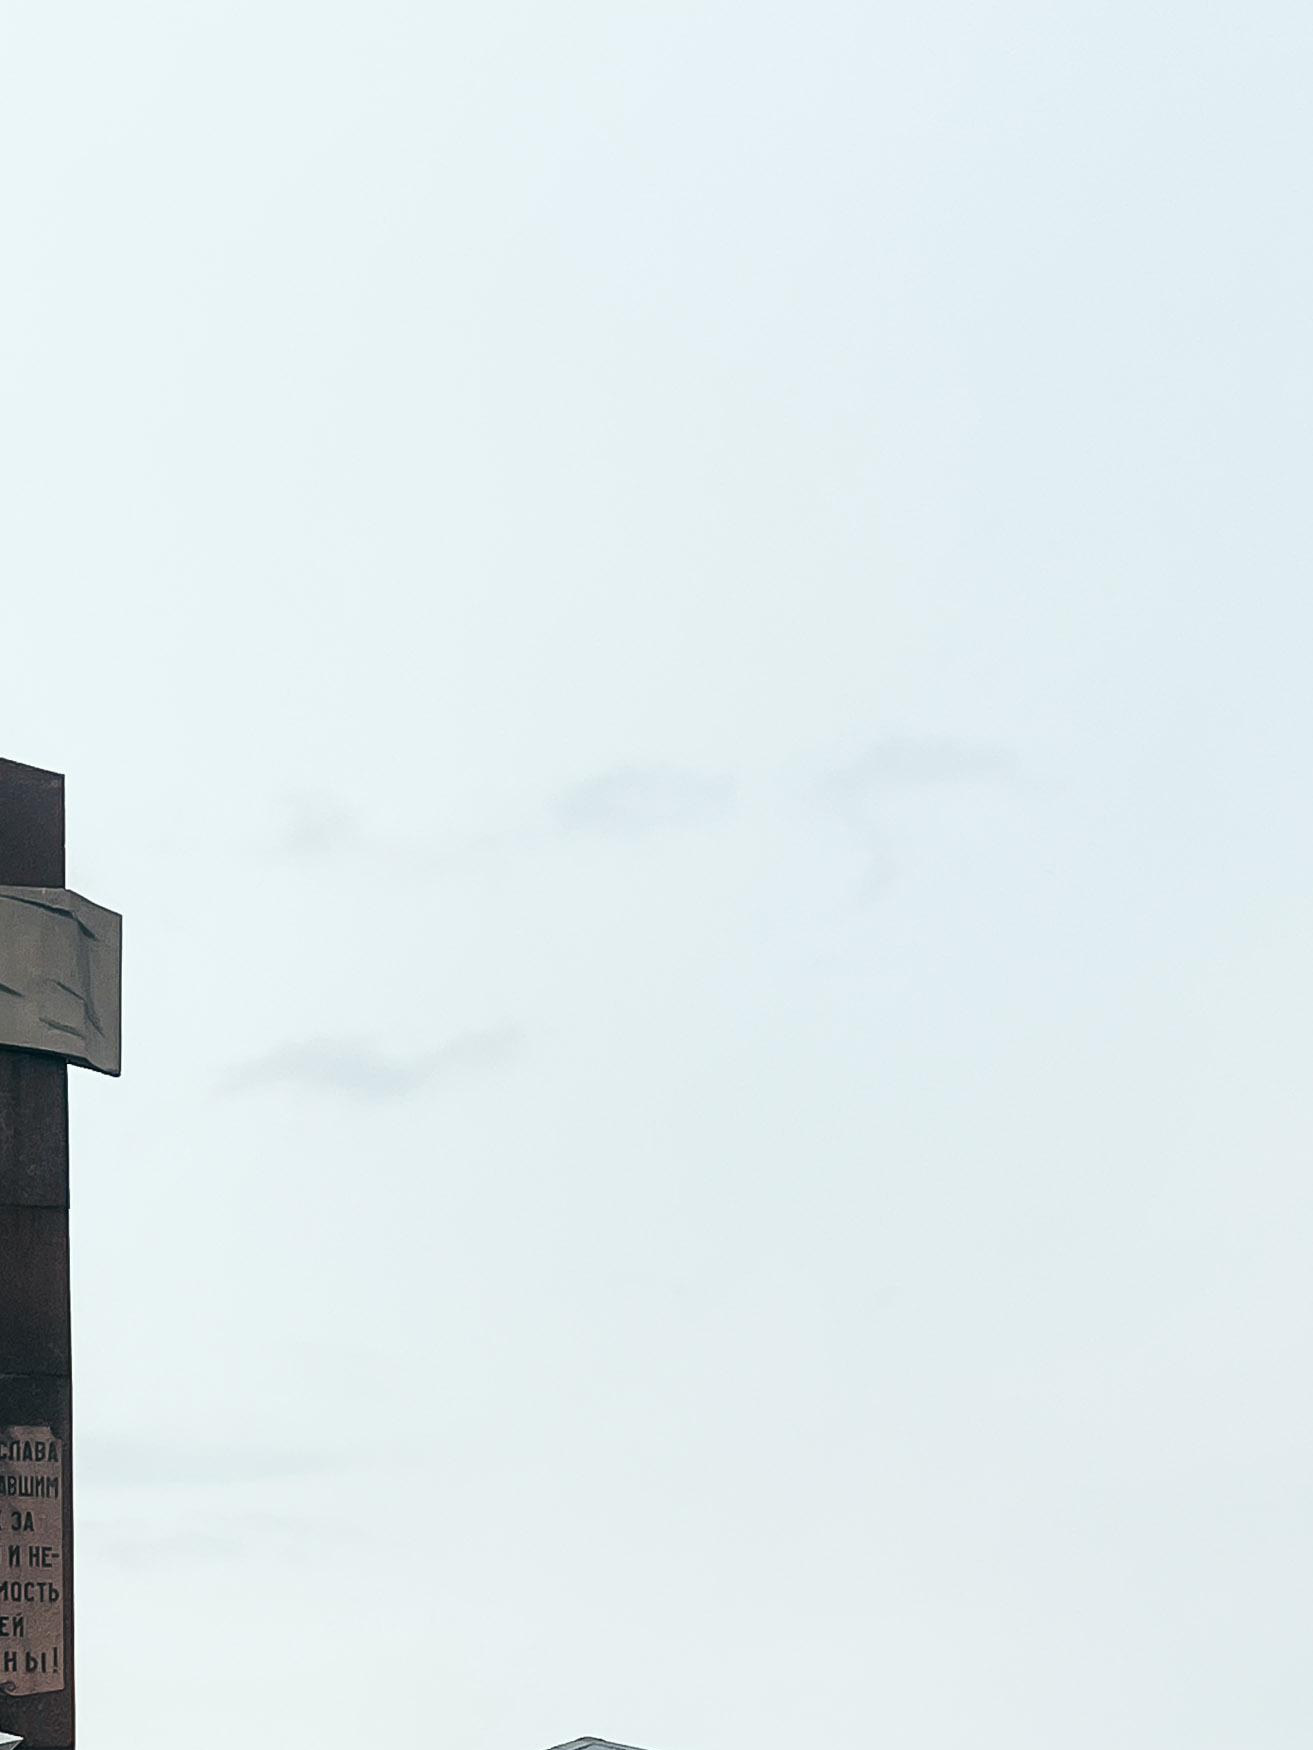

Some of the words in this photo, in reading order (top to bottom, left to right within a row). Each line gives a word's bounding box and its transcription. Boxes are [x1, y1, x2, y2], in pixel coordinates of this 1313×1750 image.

[11, 1511, 34, 1532] ЗА
[8, 1546, 20, 1567] И
[29, 1547, 60, 1568] НЕ-
